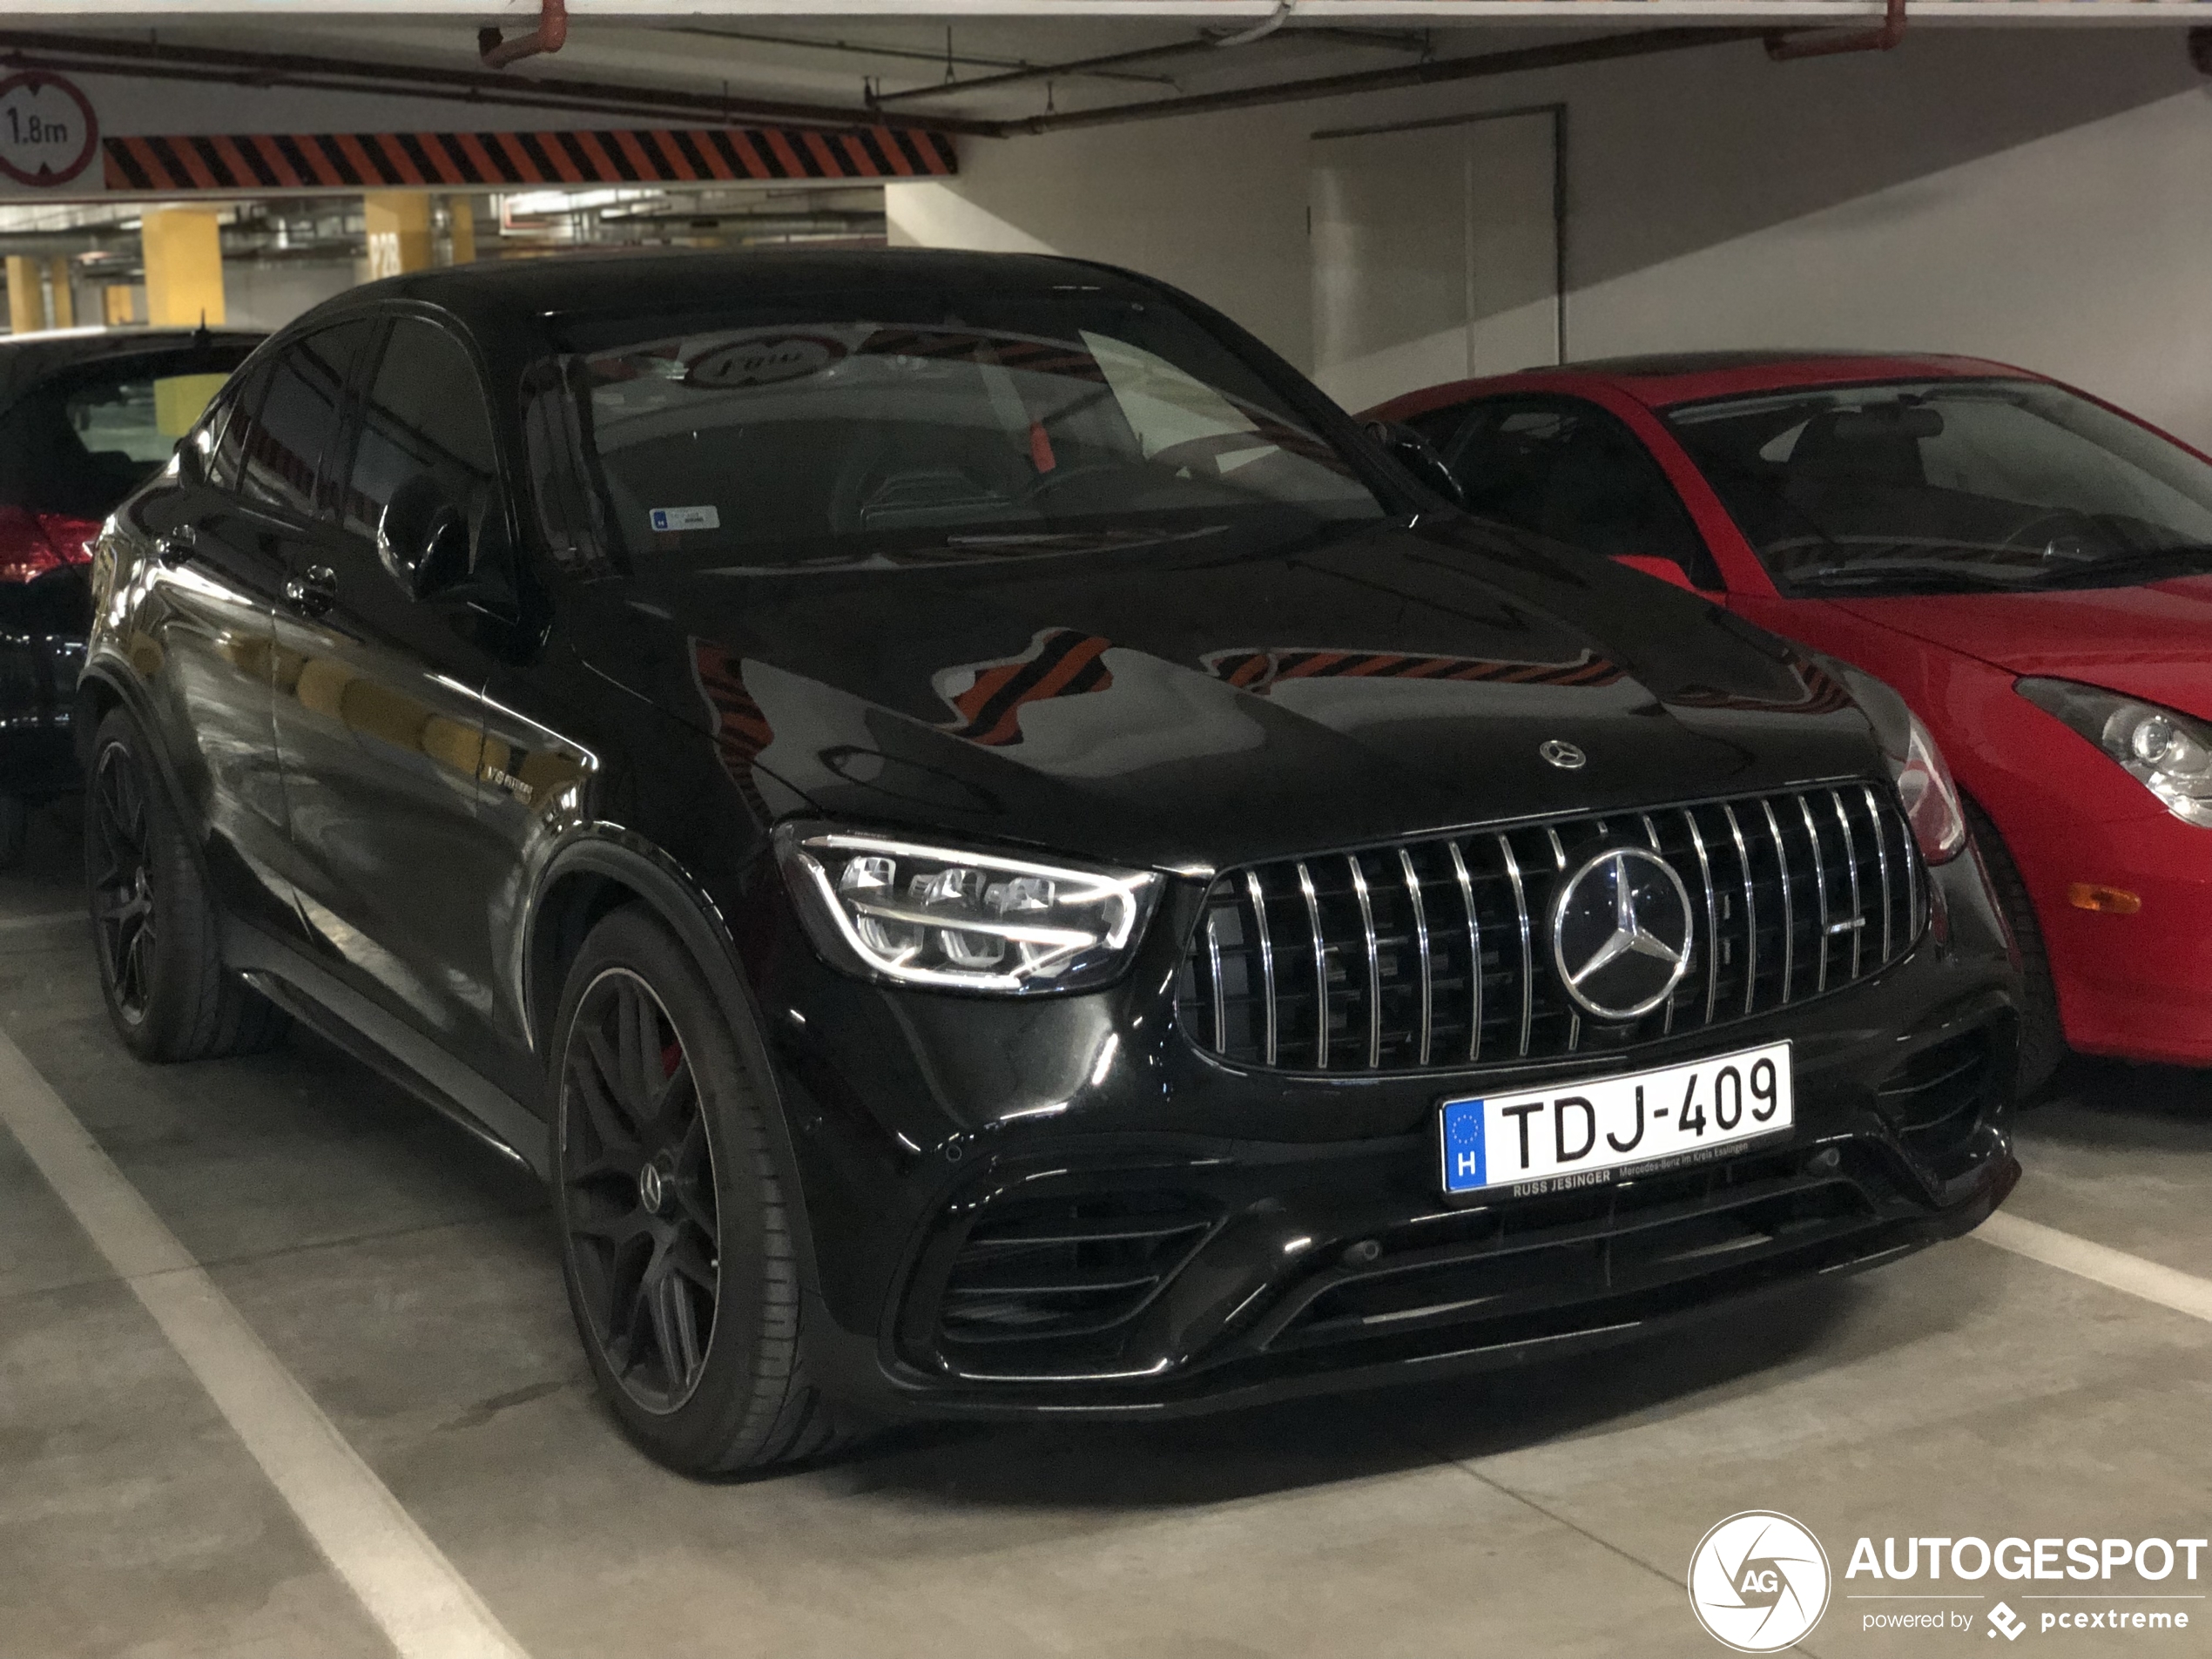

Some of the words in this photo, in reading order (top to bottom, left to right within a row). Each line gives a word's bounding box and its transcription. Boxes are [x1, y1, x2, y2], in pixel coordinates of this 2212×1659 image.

[6, 106, 67, 145] 1.8m
[1501, 1056, 1777, 1170] TDJ-409
[1458, 1150, 1476, 1177] H
[1513, 1181, 1548, 1197] RUSS
[1551, 1169, 1611, 1192] JESINGER
[1619, 1156, 1680, 1177] Mercedes-Benz
[1682, 1153, 1691, 1164] im
[1693, 1149, 1712, 1162] Kreis
[1714, 1142, 1749, 1157] Esslingen
